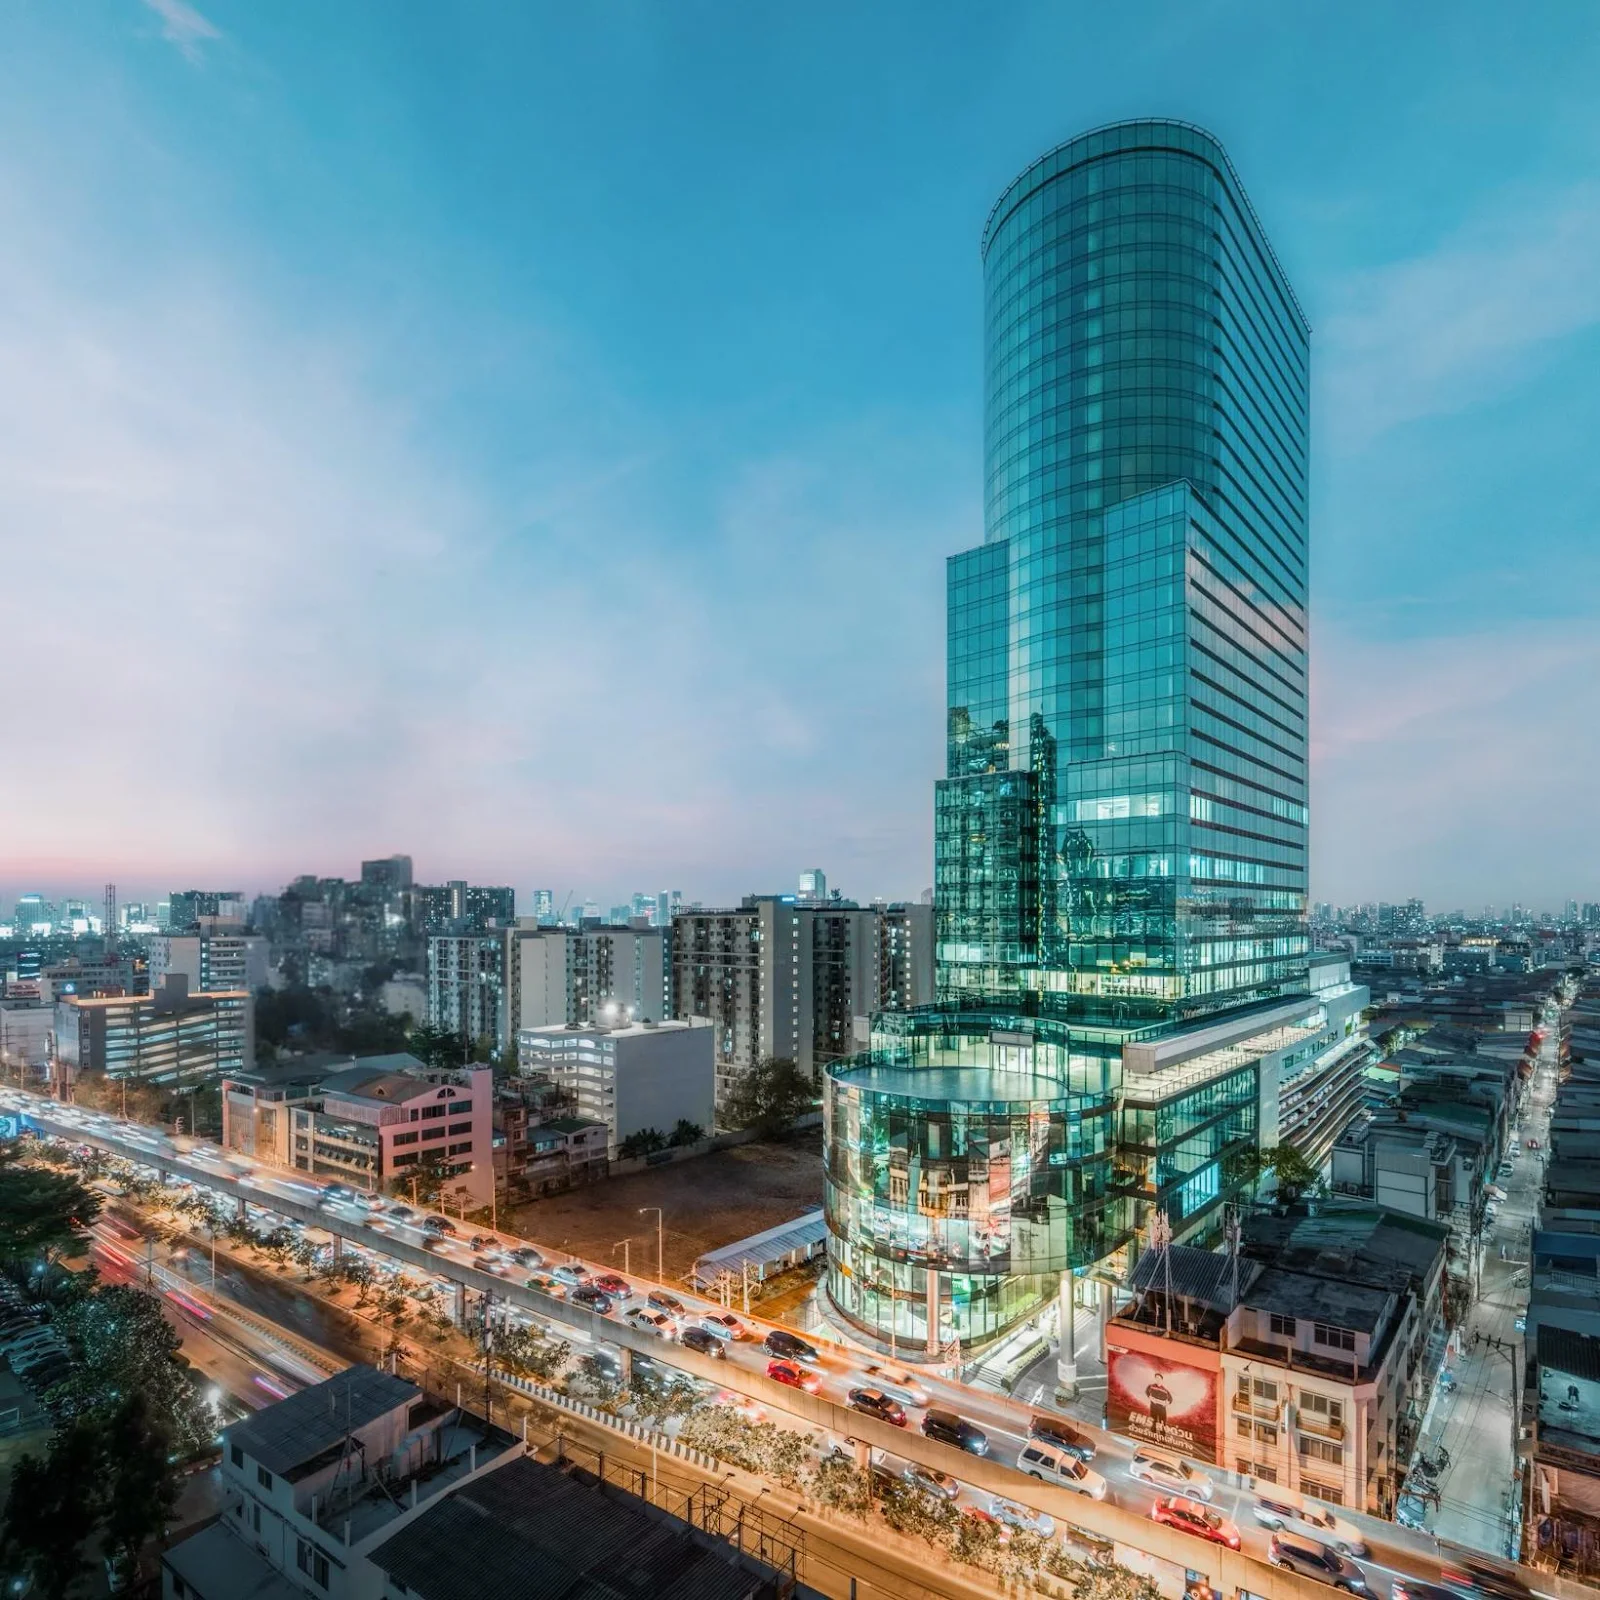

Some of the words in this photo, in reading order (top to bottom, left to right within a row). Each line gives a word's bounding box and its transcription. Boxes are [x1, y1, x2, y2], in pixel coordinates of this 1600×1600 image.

[1128, 1411, 1154, 1428] EMS
[1155, 1420, 1193, 1441] ส่งด่วน
